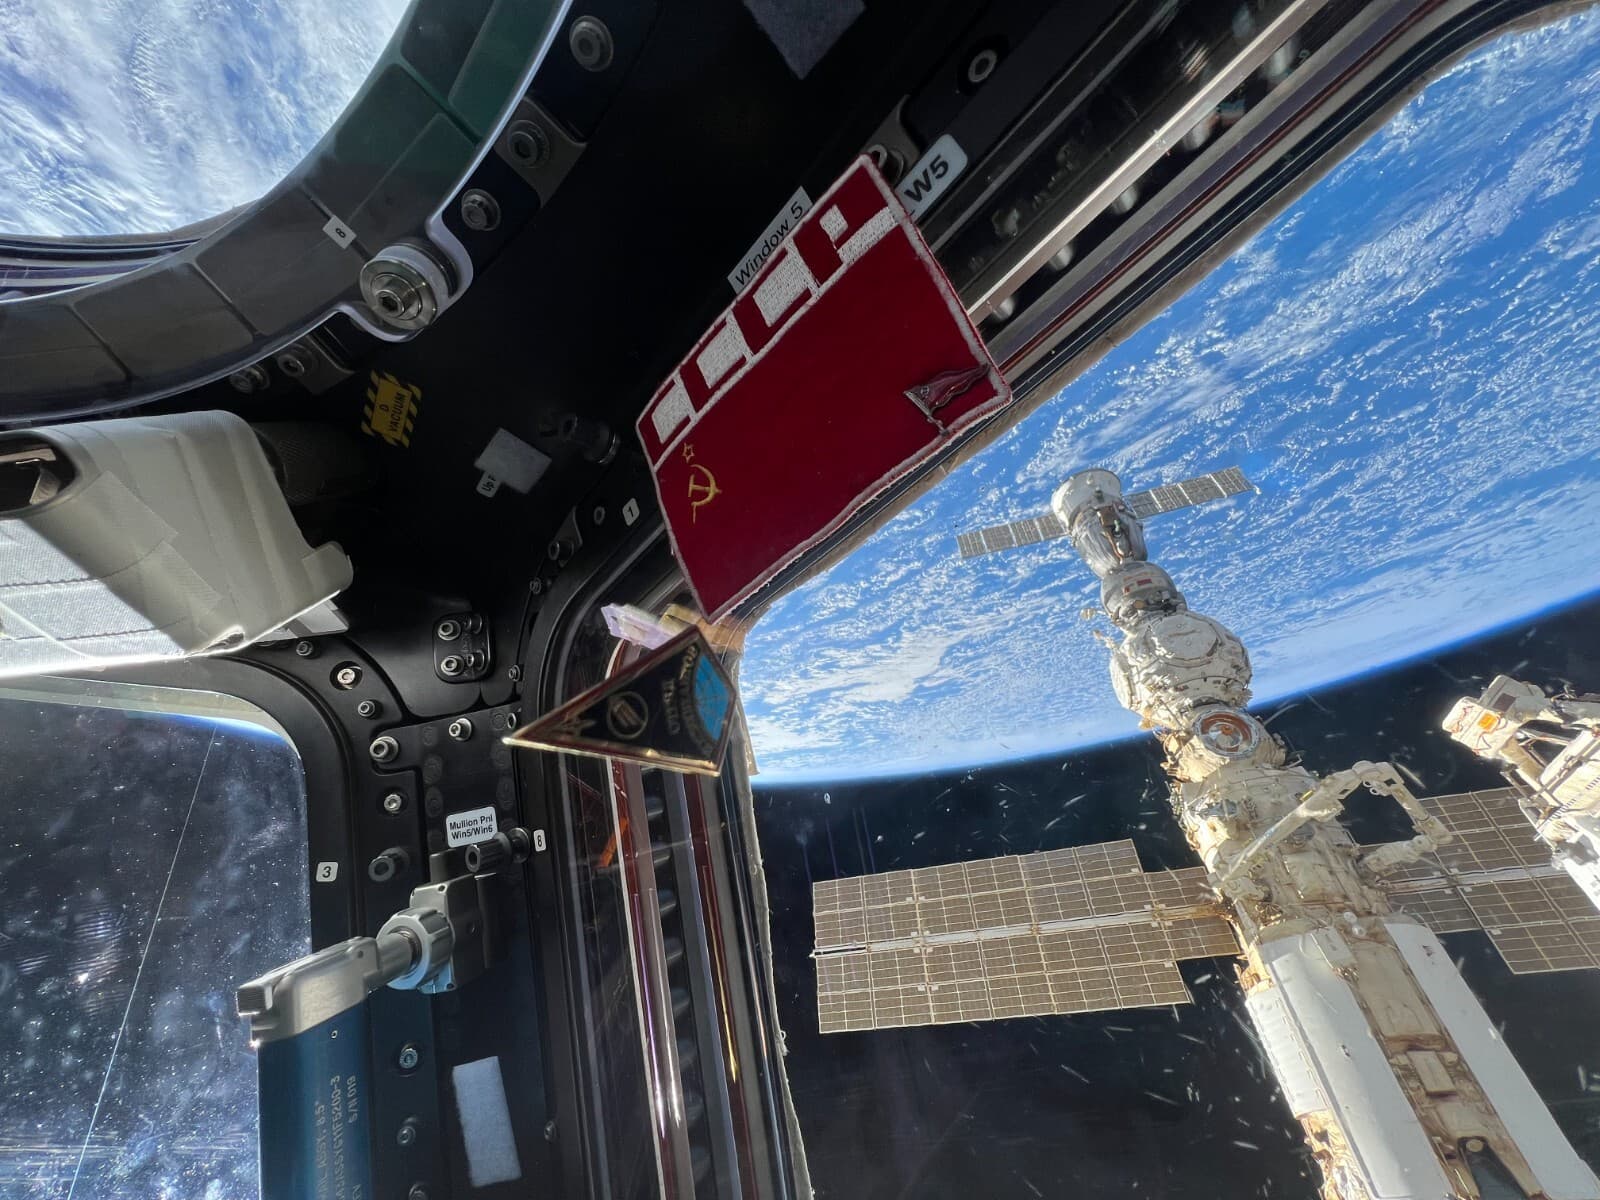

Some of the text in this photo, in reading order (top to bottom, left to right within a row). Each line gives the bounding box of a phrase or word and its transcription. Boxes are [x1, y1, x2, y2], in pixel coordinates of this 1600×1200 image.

[903, 154, 950, 204] W5
[335, 227, 346, 239] 8
[735, 201, 804, 286] Window 5
[389, 391, 406, 432] VACUUM
[627, 506, 634, 518] 1
[449, 814, 494, 831] Mullion Pnl
[451, 825, 494, 841] Win5/Win6
[536, 834, 543, 848] 8
[322, 865, 332, 879] 3
